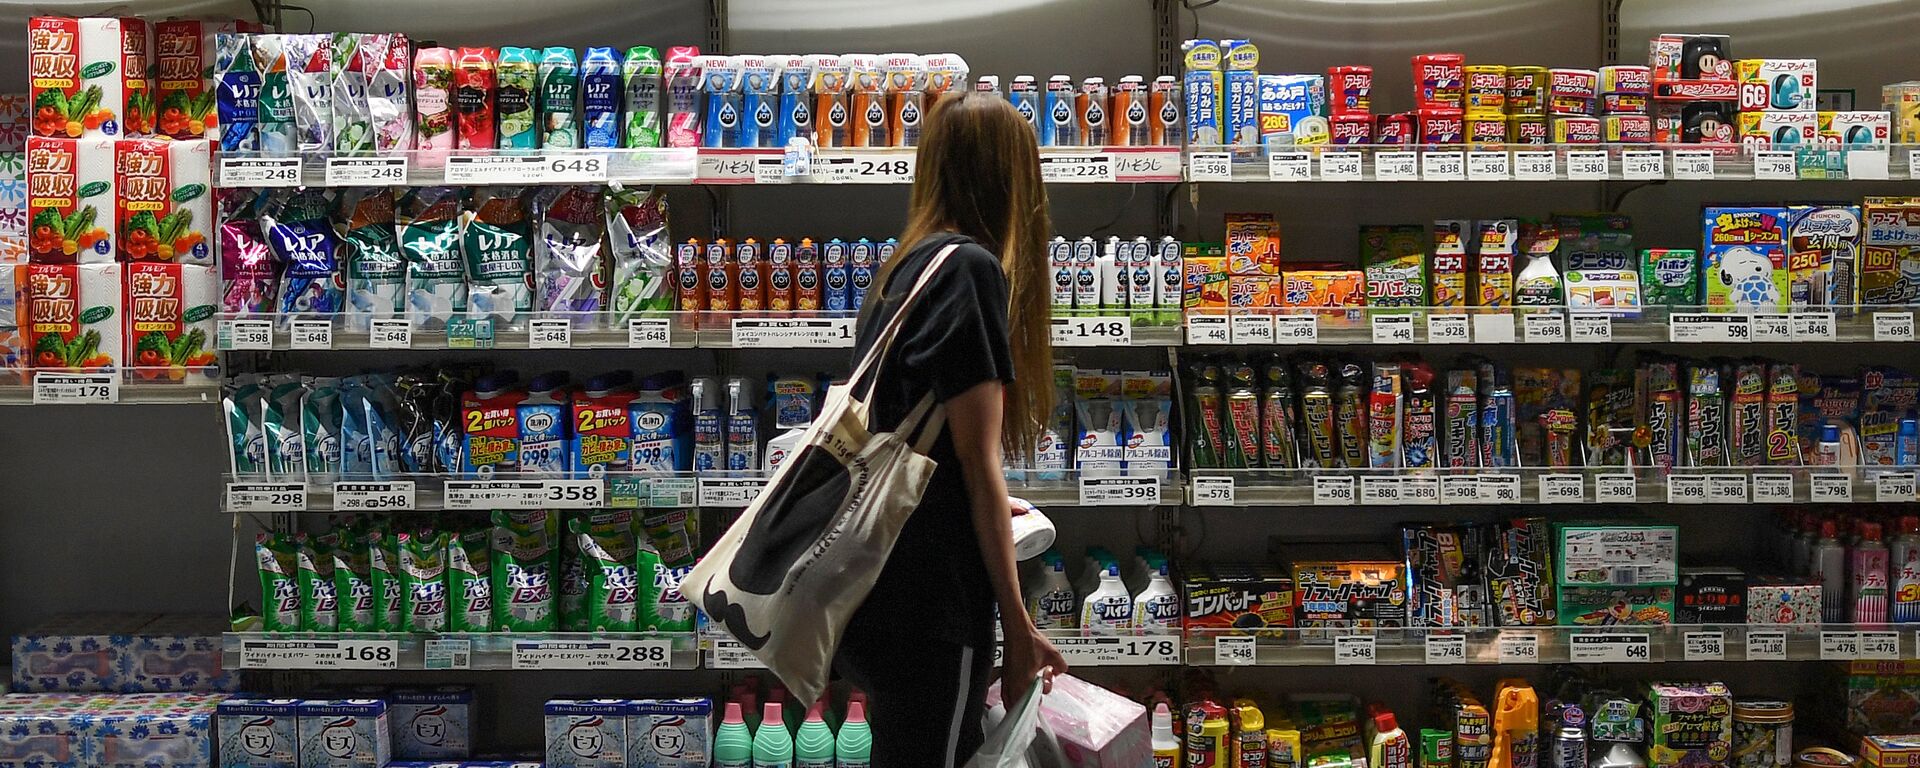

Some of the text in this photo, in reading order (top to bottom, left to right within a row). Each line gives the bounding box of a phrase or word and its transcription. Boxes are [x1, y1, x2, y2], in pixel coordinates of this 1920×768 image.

[31, 30, 73, 52] 強力
[158, 33, 198, 56] 強力
[705, 60, 727, 68] NEW!
[744, 59, 765, 67] NEW!
[818, 58, 839, 66] NEW!
[888, 58, 909, 66] NEW!
[928, 58, 947, 66] NEW!
[1657, 55, 1669, 67] 60
[32, 54, 75, 78] 吸収
[160, 57, 199, 79] 吸収
[587, 84, 610, 93] レノア
[1261, 86, 1306, 101] あみ戸
[1200, 82, 1212, 119] あみ戸
[1243, 82, 1254, 119] あみ戸
[721, 111, 734, 120] JOY
[794, 111, 807, 119] JOY
[903, 110, 916, 119] JOY
[1088, 112, 1101, 120] JOY
[31, 149, 72, 172] 強力
[126, 153, 163, 176] 強力
[1801, 155, 1825, 165] アプリ
[552, 160, 599, 172] 648
[861, 161, 908, 175] 248
[1077, 165, 1107, 175] 228
[1208, 165, 1226, 173] 598
[1339, 164, 1357, 173] 548
[1395, 165, 1412, 173] 1,480
[1440, 164, 1459, 173] 838
[1486, 164, 1504, 173] 580
[1532, 164, 1551, 172] 838
[1585, 164, 1603, 172] 580
[1640, 163, 1659, 172] 678
[1691, 163, 1709, 172] 1,080
[1772, 164, 1790, 172] 798
[266, 169, 296, 179] 248
[372, 168, 402, 178] 248
[1291, 167, 1307, 176] 748
[32, 174, 73, 196] 吸収
[127, 177, 165, 200] 吸収
[1872, 213, 1900, 225] アース
[1799, 219, 1852, 232] 虫コナーズ
[1231, 231, 1258, 241] コバエ
[480, 252, 519, 260] 本格消臭
[1569, 252, 1627, 269] ダニよけ
[1433, 256, 1462, 268] ダニアース
[1481, 256, 1509, 268] ダニアース
[479, 262, 522, 273] 部屋干しDX
[682, 276, 697, 284] JOY
[741, 275, 757, 283] JOY
[800, 275, 815, 283] JOY
[854, 275, 869, 283] JOY
[1134, 274, 1150, 282] JOY
[1165, 274, 1180, 282] JOY
[31, 275, 73, 298] 強力
[133, 274, 176, 297] 強力
[1232, 283, 1258, 293] コバエ
[1287, 281, 1313, 291] コバエ
[1367, 280, 1423, 297] コバエよけ
[32, 299, 75, 322] 吸収
[135, 298, 178, 322] 吸収
[451, 324, 474, 332] アプリ
[1077, 323, 1123, 336] 148
[1250, 328, 1268, 336] 448
[1294, 328, 1312, 336] 698
[1446, 327, 1464, 336] 928
[1542, 327, 1560, 335] 698
[1589, 327, 1607, 335] 748
[1729, 326, 1747, 337] 598
[1769, 326, 1787, 334] 748
[1809, 325, 1827, 334] 848
[1891, 326, 1909, 335] 698
[249, 334, 268, 342] 598
[309, 333, 327, 342] 648
[388, 332, 406, 341] 648
[547, 333, 565, 341] 648
[647, 332, 665, 340] 648
[1209, 330, 1225, 339] 448
[1393, 329, 1410, 339] 448
[79, 387, 109, 396] 178
[484, 409, 510, 418] お買い得
[595, 408, 621, 417] お買い得
[467, 411, 483, 432] 2
[484, 416, 515, 430] 個パック
[579, 410, 594, 431] 2
[595, 416, 626, 429] 個パック
[1771, 432, 1788, 457] 2
[1079, 449, 1122, 459] アルコール除菌
[1125, 449, 1169, 459] アルコール除菌
[614, 483, 638, 492] アプリ
[1125, 487, 1156, 497] 398
[1458, 488, 1476, 496] 908
[1561, 487, 1579, 495] 698
[1613, 487, 1631, 495] 980
[1685, 487, 1703, 496] 698
[1724, 487, 1742, 495] 980
[1771, 487, 1789, 495] 1,380
[1828, 487, 1846, 495] 798
[1894, 485, 1912, 494] 780
[549, 486, 597, 500] 358
[1211, 490, 1229, 498] 578
[1331, 489, 1350, 498] 908
[1379, 489, 1397, 497] 880
[1416, 489, 1435, 497] 880
[1497, 489, 1513, 500] 980
[272, 494, 302, 504] 298
[380, 495, 405, 507] 548
[520, 588, 541, 600] EX
[613, 588, 634, 600] EX
[1300, 580, 1397, 600] ブラックキャップ
[1190, 589, 1257, 617] コンバット
[1303, 601, 1347, 613] 1年間効く!
[1127, 641, 1173, 655] 178
[1352, 648, 1371, 657] 548
[1443, 648, 1461, 656] 748
[1516, 647, 1534, 655] 548
[1627, 646, 1646, 657] 648
[1701, 643, 1719, 653] 398
[1764, 644, 1782, 652] 1,180
[1837, 644, 1857, 654] 478
[1877, 644, 1895, 652] 478
[345, 647, 390, 661] 168
[617, 647, 664, 661] 288
[1233, 649, 1251, 657] 548
[245, 735, 270, 749] ビーズ
[326, 735, 351, 749] ビーズ
[573, 735, 598, 749] ビーズ
[655, 735, 679, 749] ビーズ
